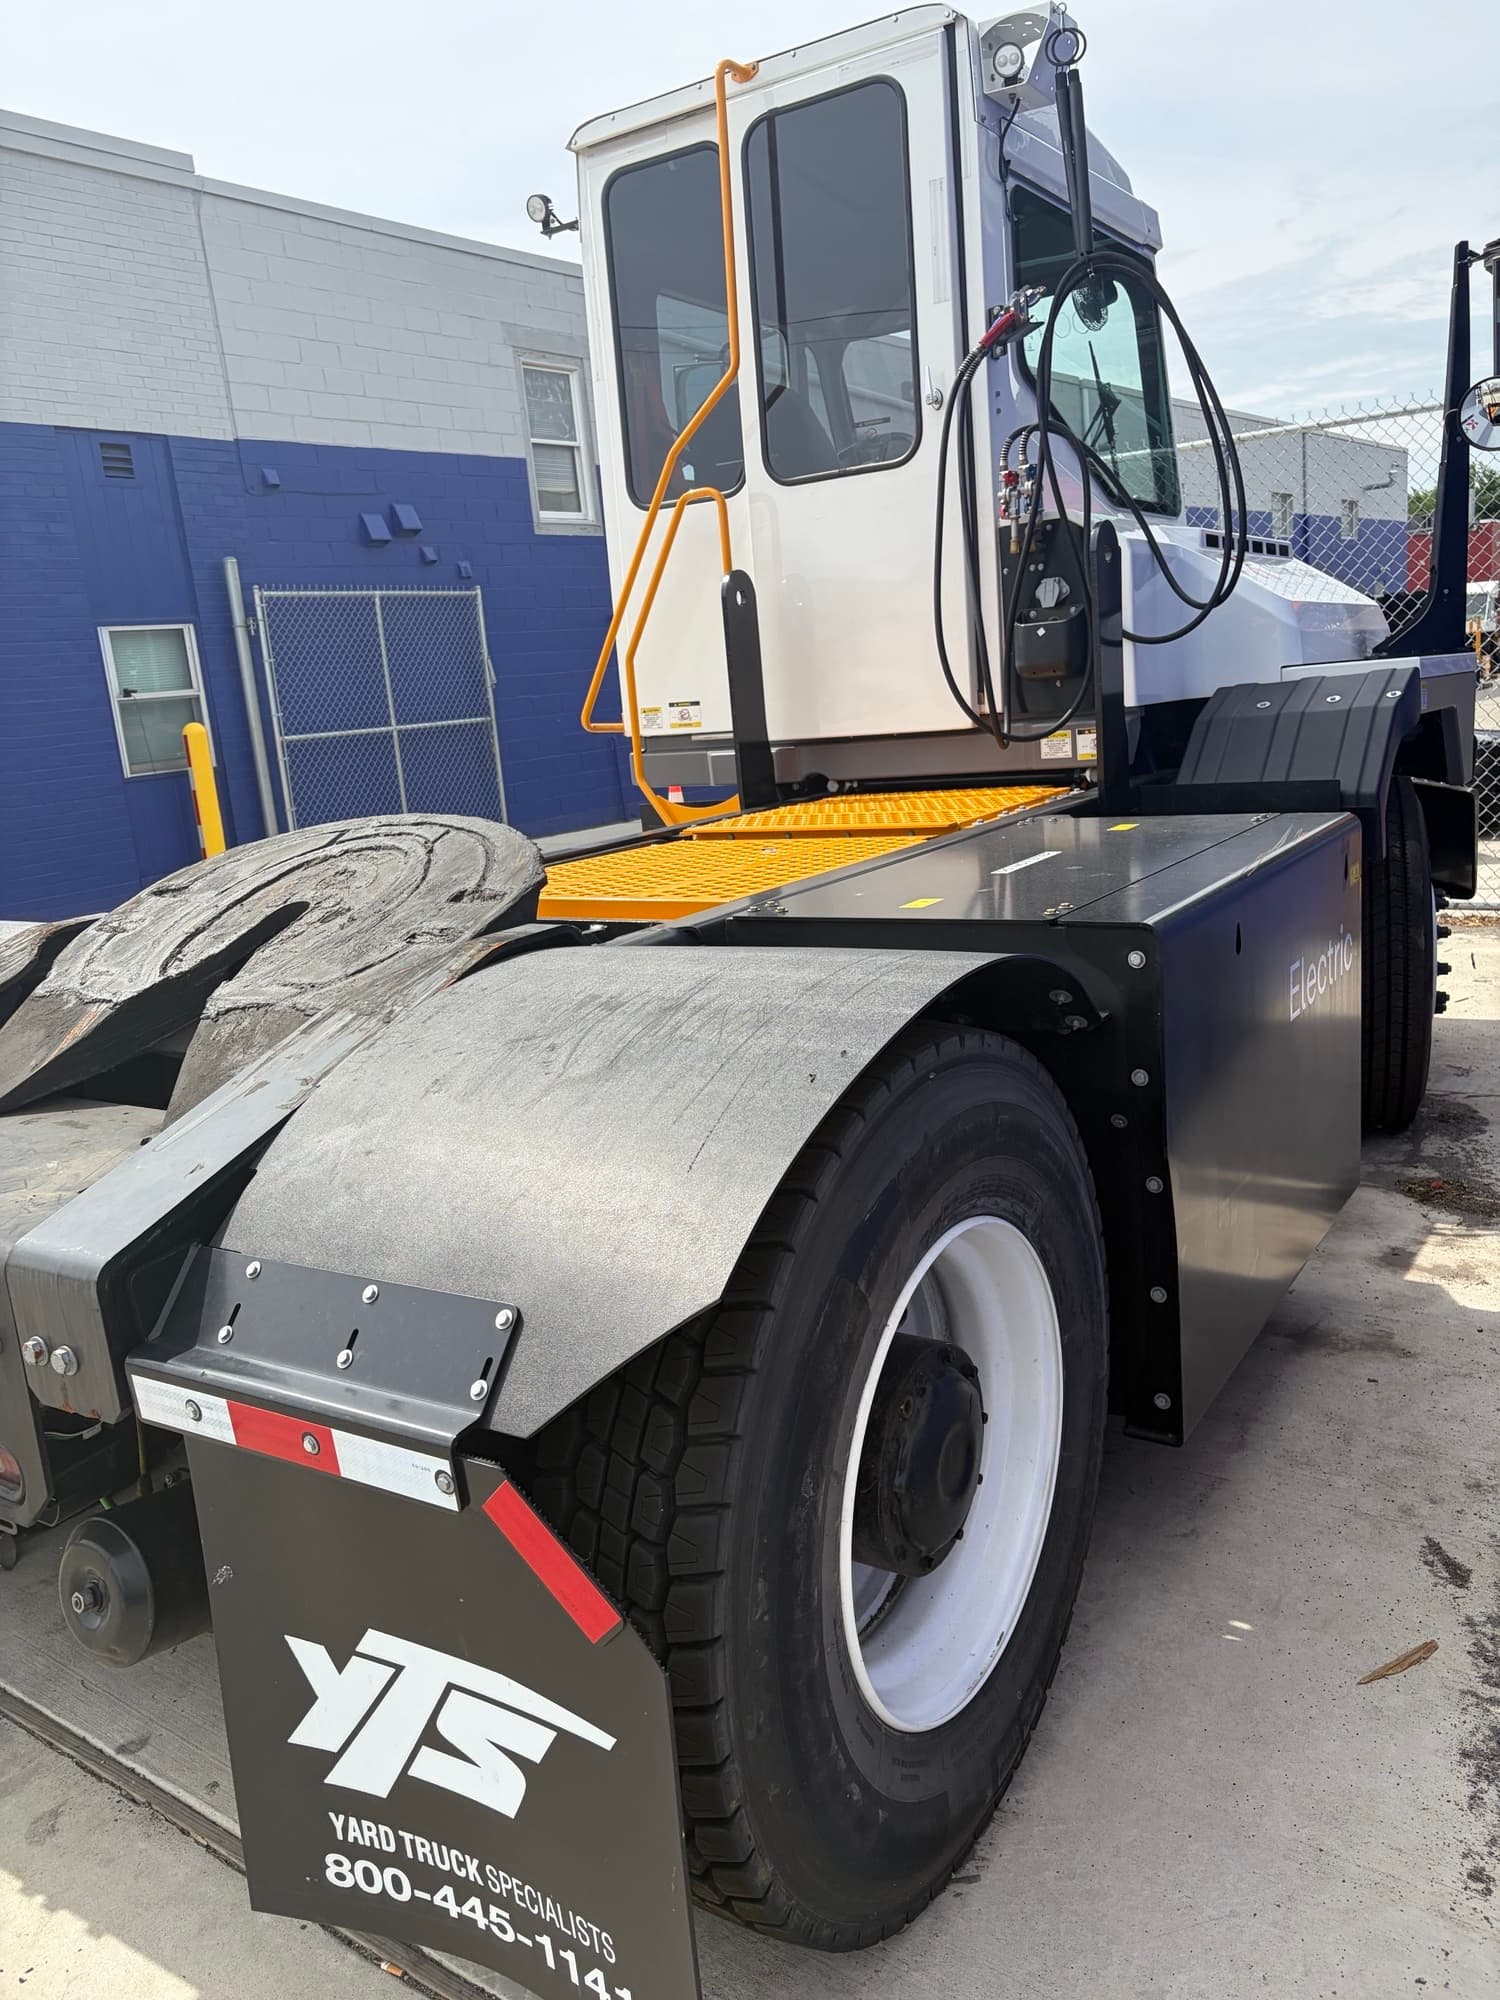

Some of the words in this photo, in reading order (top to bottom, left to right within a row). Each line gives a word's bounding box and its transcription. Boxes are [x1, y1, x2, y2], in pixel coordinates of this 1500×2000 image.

[1289, 923, 1353, 1022] Electric
[283, 1627, 617, 1819] YTS
[328, 1811, 396, 1853] YARD
[398, 1829, 485, 1887] TRUCK
[485, 1864, 616, 1964] SPECIALISTS
